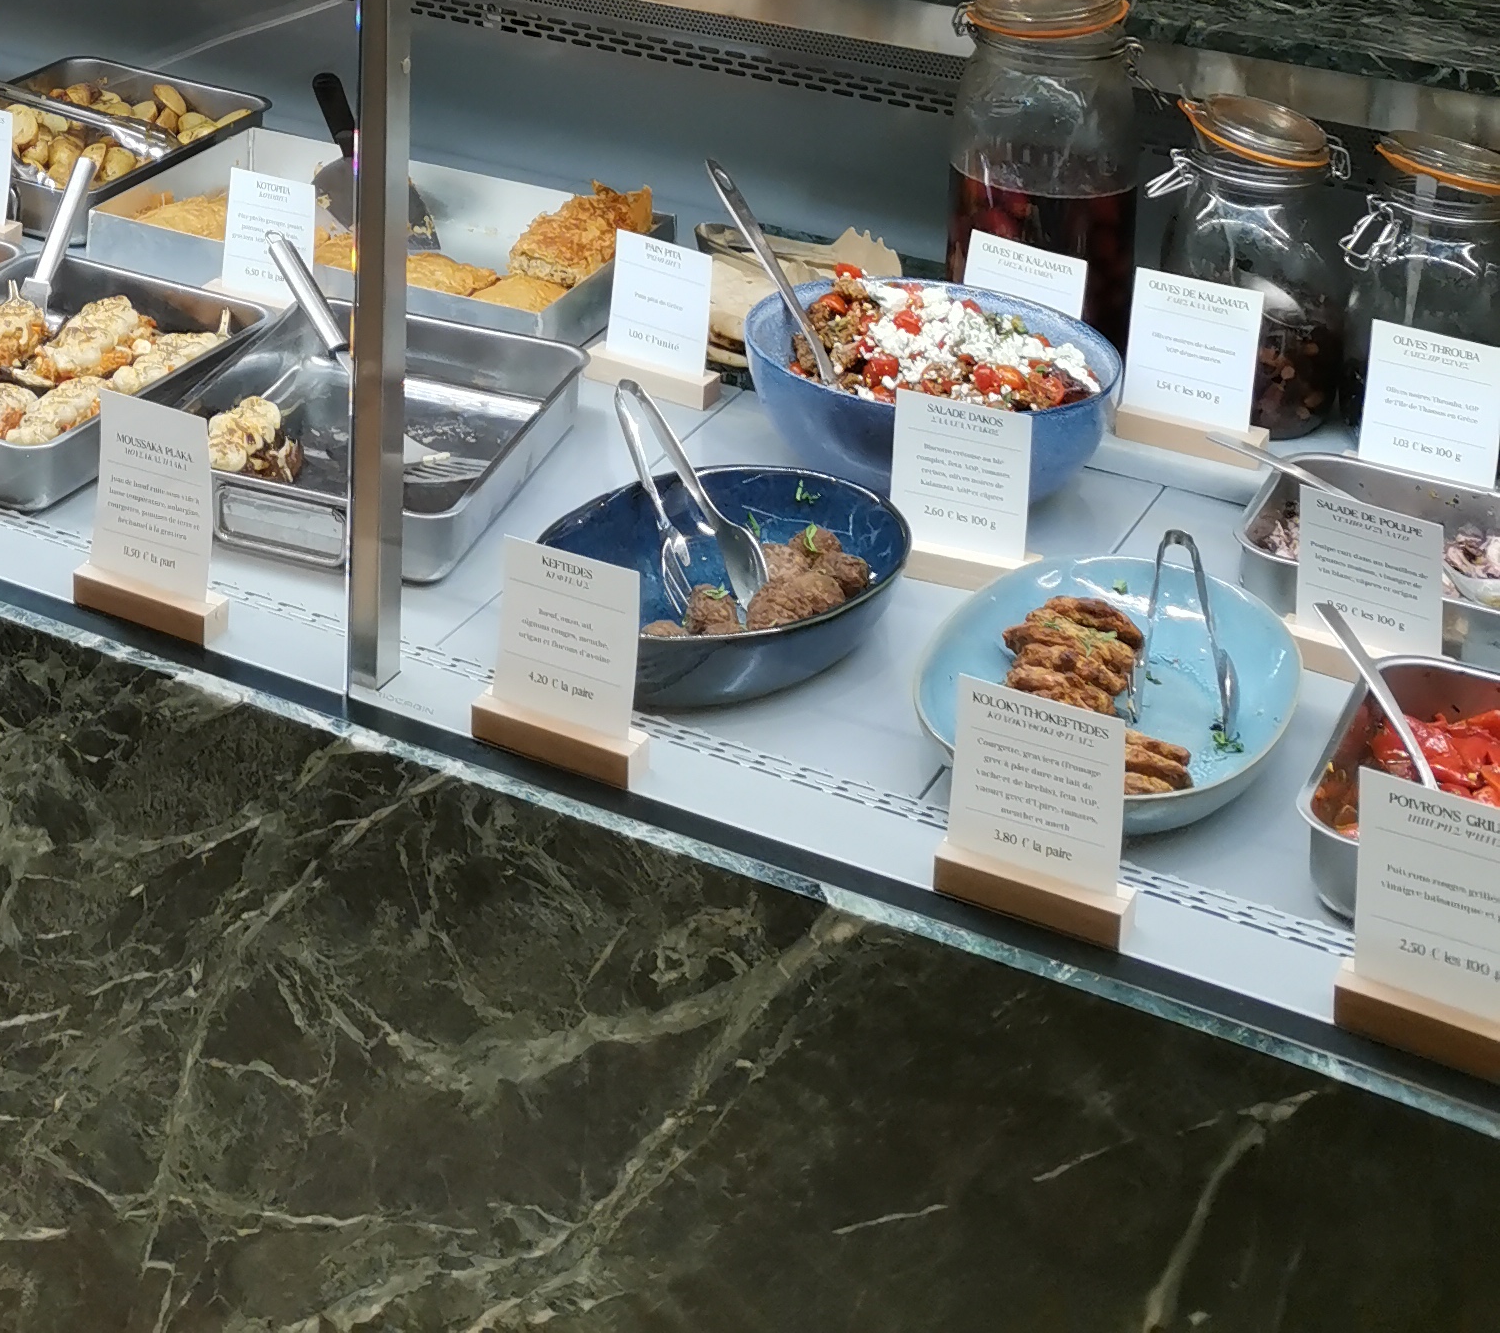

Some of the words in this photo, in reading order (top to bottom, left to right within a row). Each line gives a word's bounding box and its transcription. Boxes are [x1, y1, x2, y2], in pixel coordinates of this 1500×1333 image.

[982, 242, 1011, 260] OLIVES
[1012, 249, 1025, 263] DE
[1026, 253, 1074, 277] KALAMATA
[1148, 279, 1181, 297] OLIVES
[1182, 287, 1196, 300] DE
[1198, 291, 1250, 312] KALAMATA
[1393, 335, 1428, 350] OLIVES
[1430, 343, 1480, 363] THROUBA
[1182, 385, 1194, 397] les
[1196, 389, 1213, 402] 100
[927, 403, 966, 420] SALADE
[968, 412, 1004, 428] DAKOS
[116, 431, 164, 455] MOUSSAKA
[165, 446, 194, 464] PLAKA
[1421, 443, 1434, 454] les
[1435, 446, 1453, 459] 100
[1455, 453, 1462, 462] g
[956, 512, 968, 523] les
[971, 514, 988, 527] 100
[990, 520, 997, 531] g
[1316, 498, 1358, 518] SALADE
[1361, 511, 1376, 523] DE
[1379, 517, 1423, 538] POULPE
[541, 555, 593, 579] KEFTEDES
[1361, 609, 1374, 621] les
[1377, 614, 1396, 627] 100
[1398, 622, 1405, 632] g
[560, 680, 569, 693] la
[571, 684, 594, 700] paire
[972, 690, 1110, 741] KOLOKYTHOKEFTEDES
[1388, 792, 1462, 823] POIVRONS
[1465, 813, 1500, 836] GRIL
[1032, 840, 1042, 853] la
[1045, 845, 1073, 862] paire
[1444, 951, 1461, 967] les
[1465, 957, 1491, 976] 100
